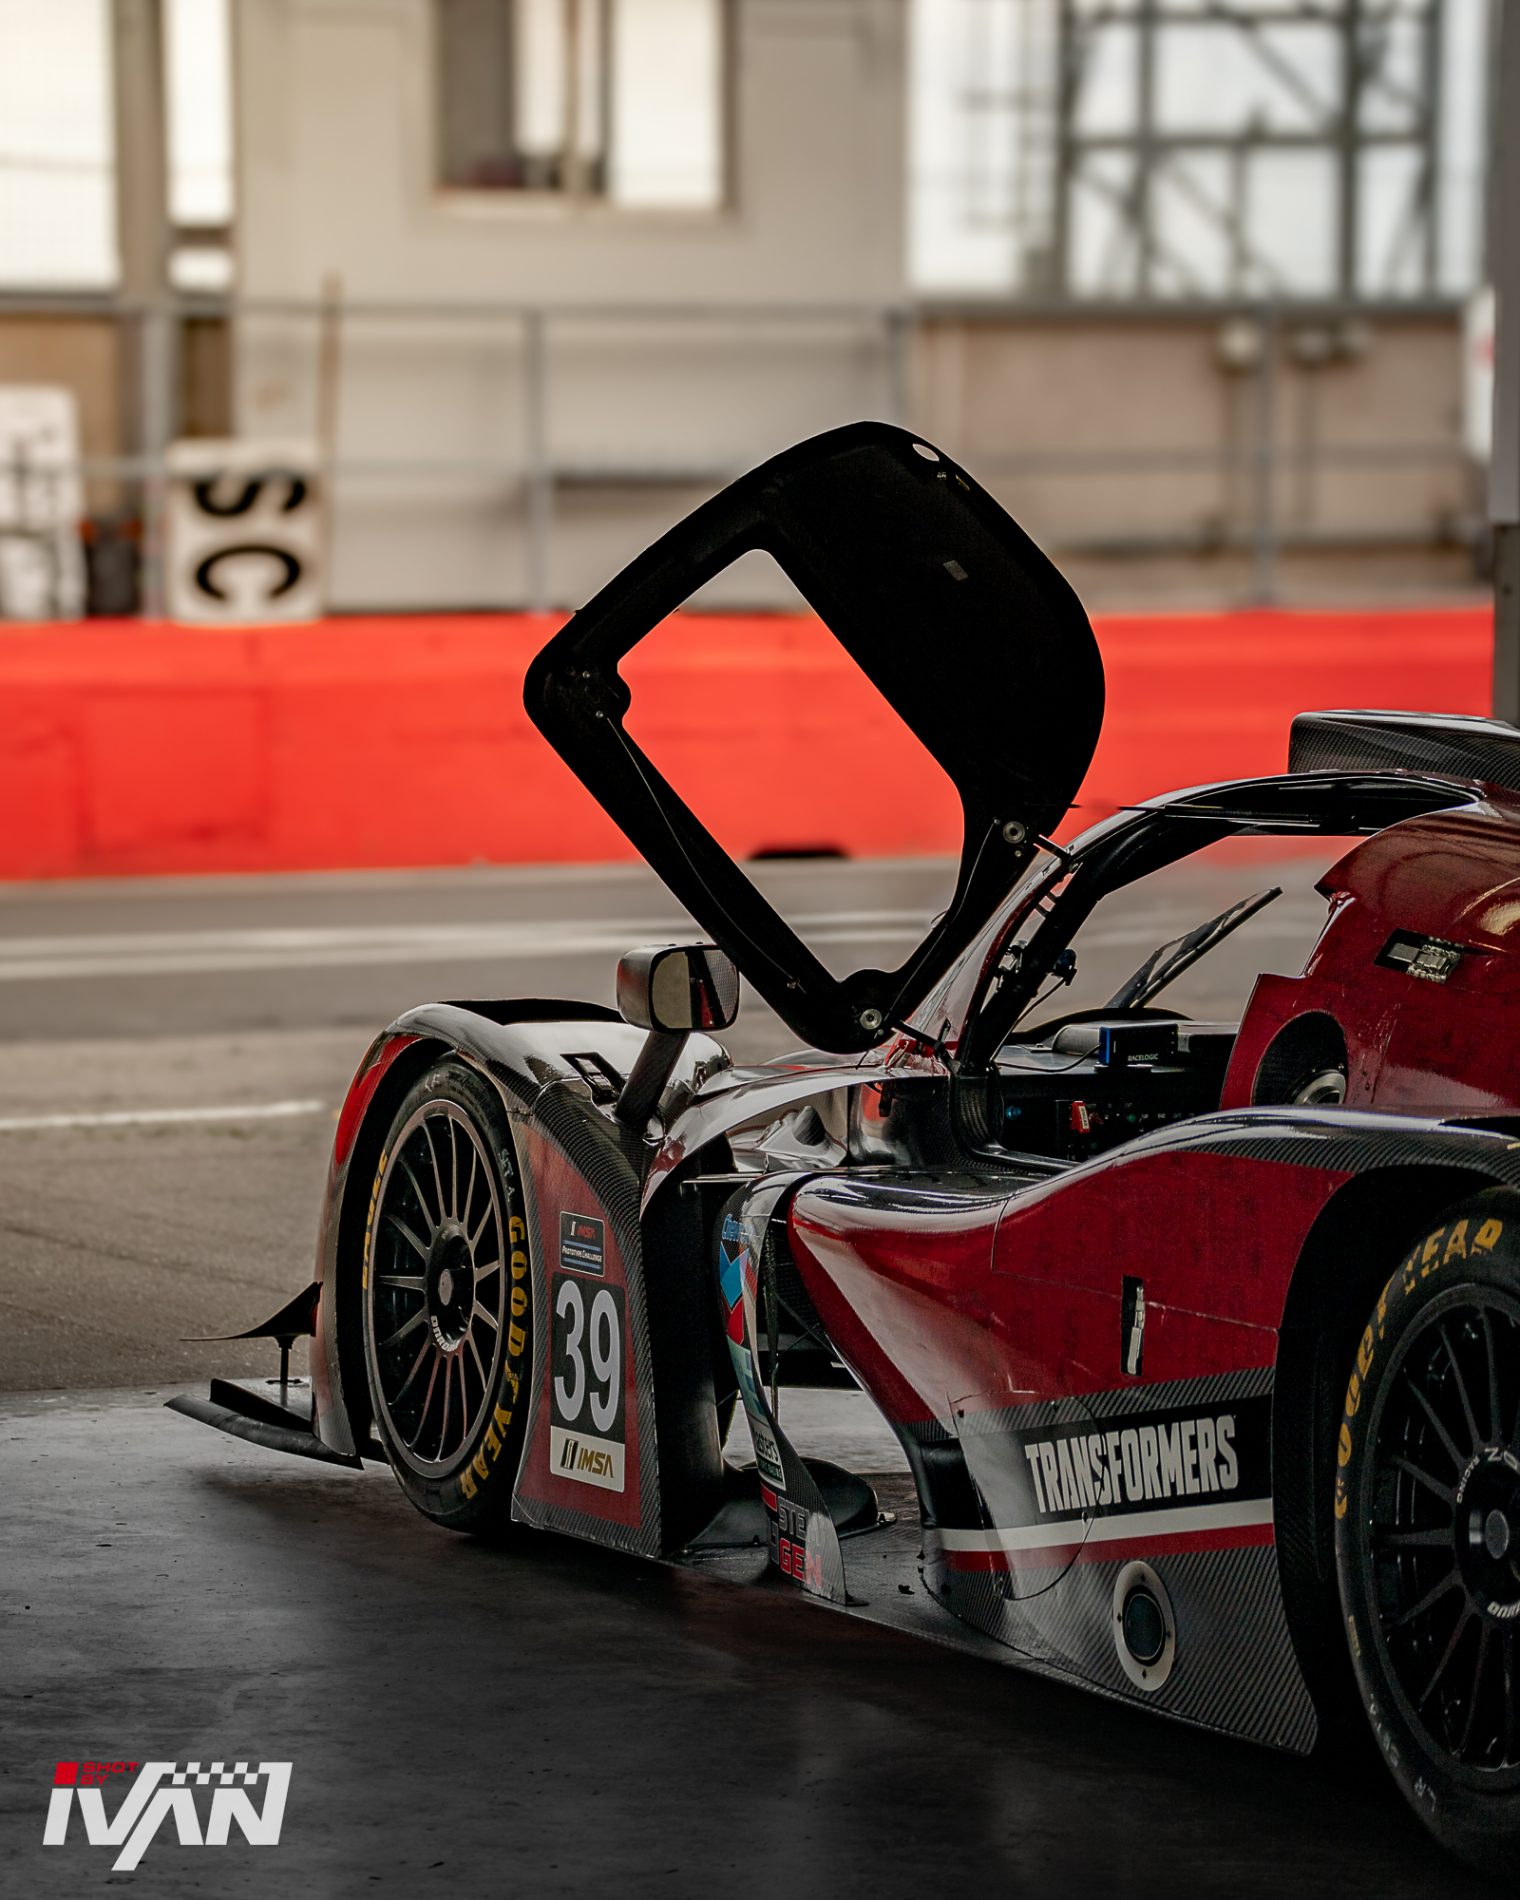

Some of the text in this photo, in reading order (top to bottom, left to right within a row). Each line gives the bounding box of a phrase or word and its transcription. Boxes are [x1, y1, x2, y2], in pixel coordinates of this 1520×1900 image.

[195, 472, 305, 601] SC
[554, 1279, 621, 1432] 39
[1024, 1414, 1239, 1513] TRANSFORMERS
